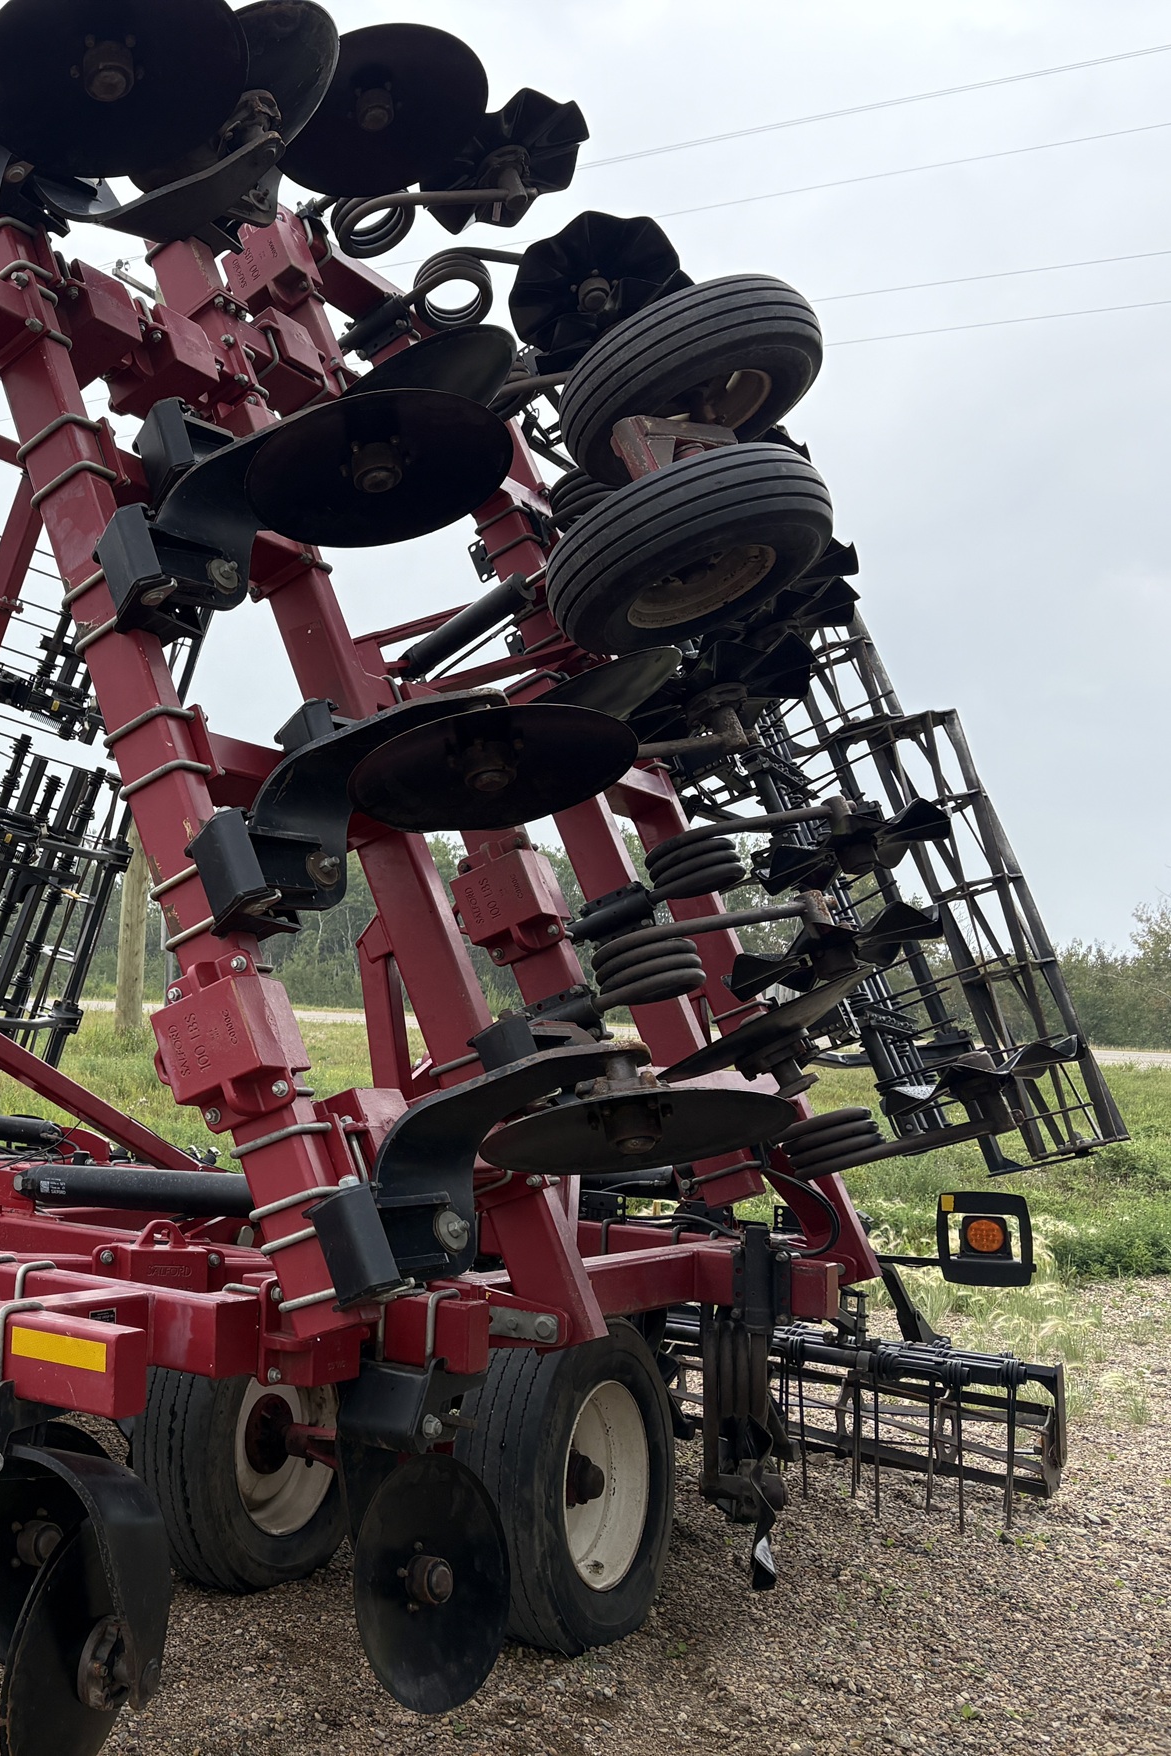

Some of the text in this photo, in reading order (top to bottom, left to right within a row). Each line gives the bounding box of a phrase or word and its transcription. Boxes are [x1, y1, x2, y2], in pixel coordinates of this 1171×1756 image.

[464, 887, 484, 925] SALFORD
[478, 878, 501, 920] 100 LBS
[168, 1024, 191, 1078] SALFORD
[184, 1012, 211, 1071] 100 LBS
[147, 1265, 192, 1278] SALFORD
